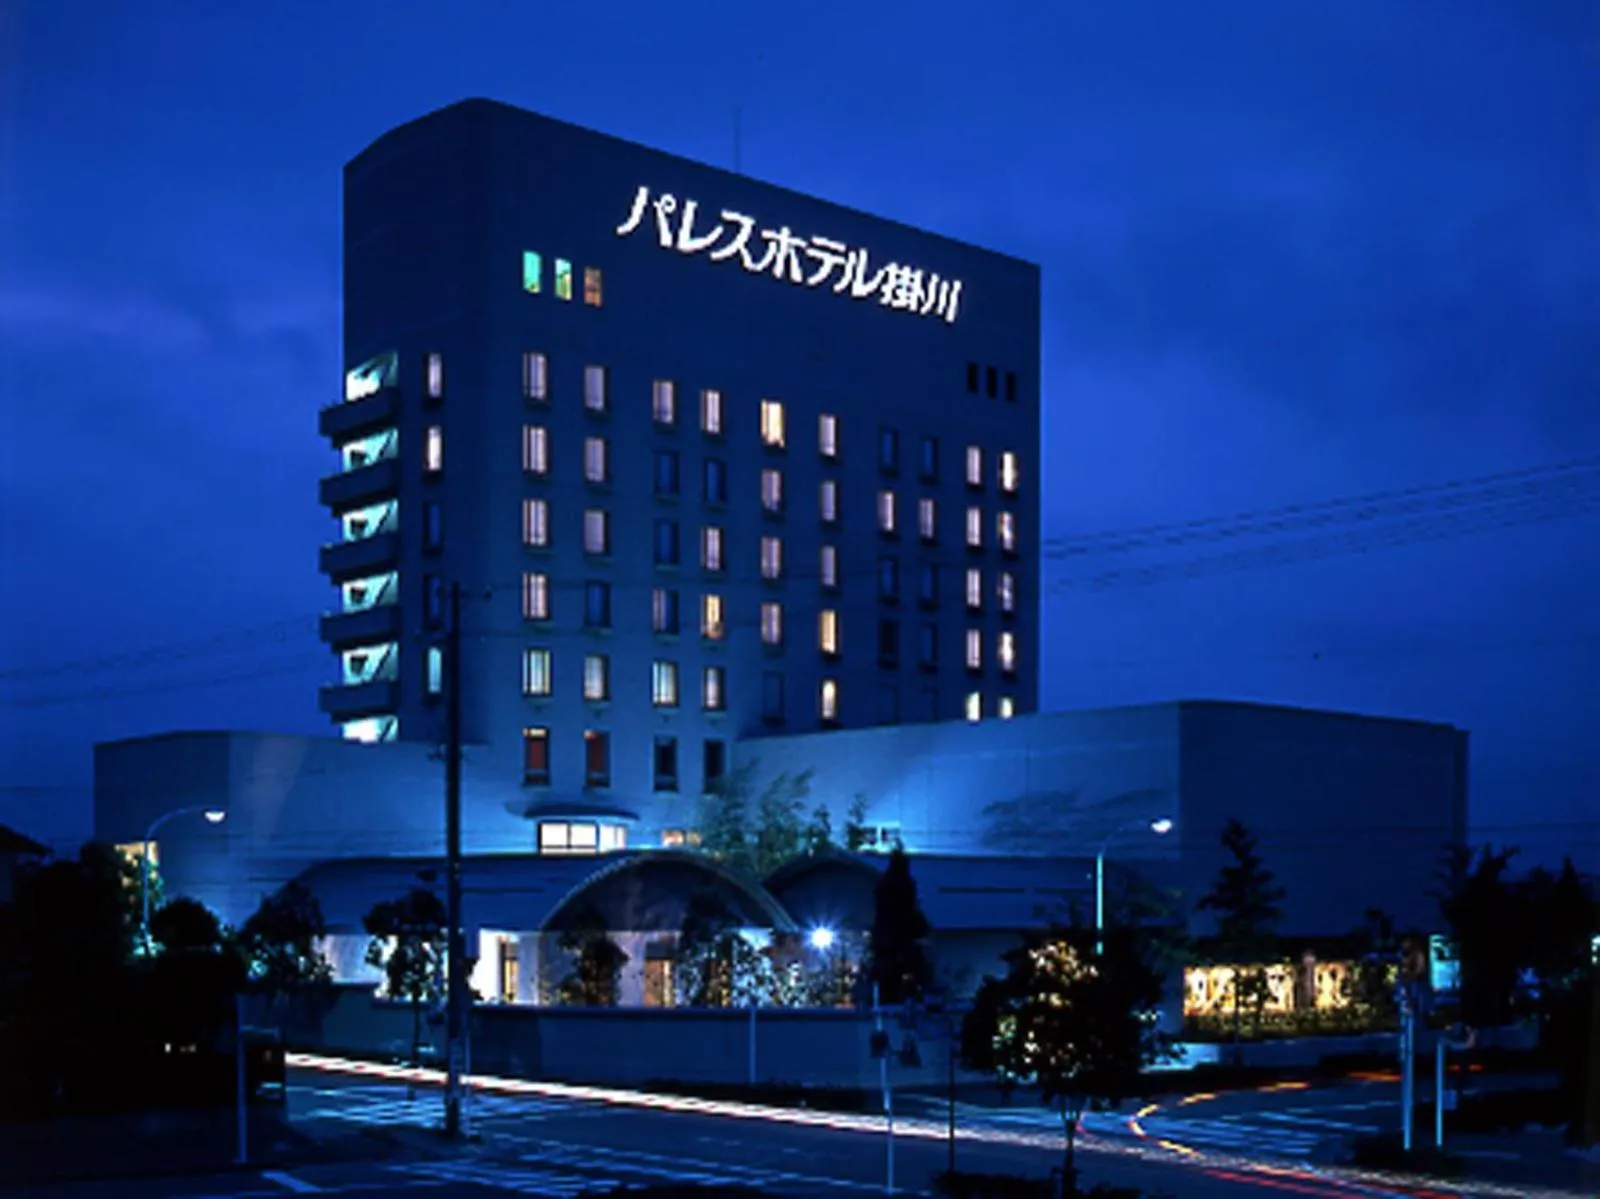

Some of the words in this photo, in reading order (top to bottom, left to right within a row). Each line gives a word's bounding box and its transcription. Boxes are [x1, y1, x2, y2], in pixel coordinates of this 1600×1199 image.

[616, 185, 962, 323] パレスホテル掛川
